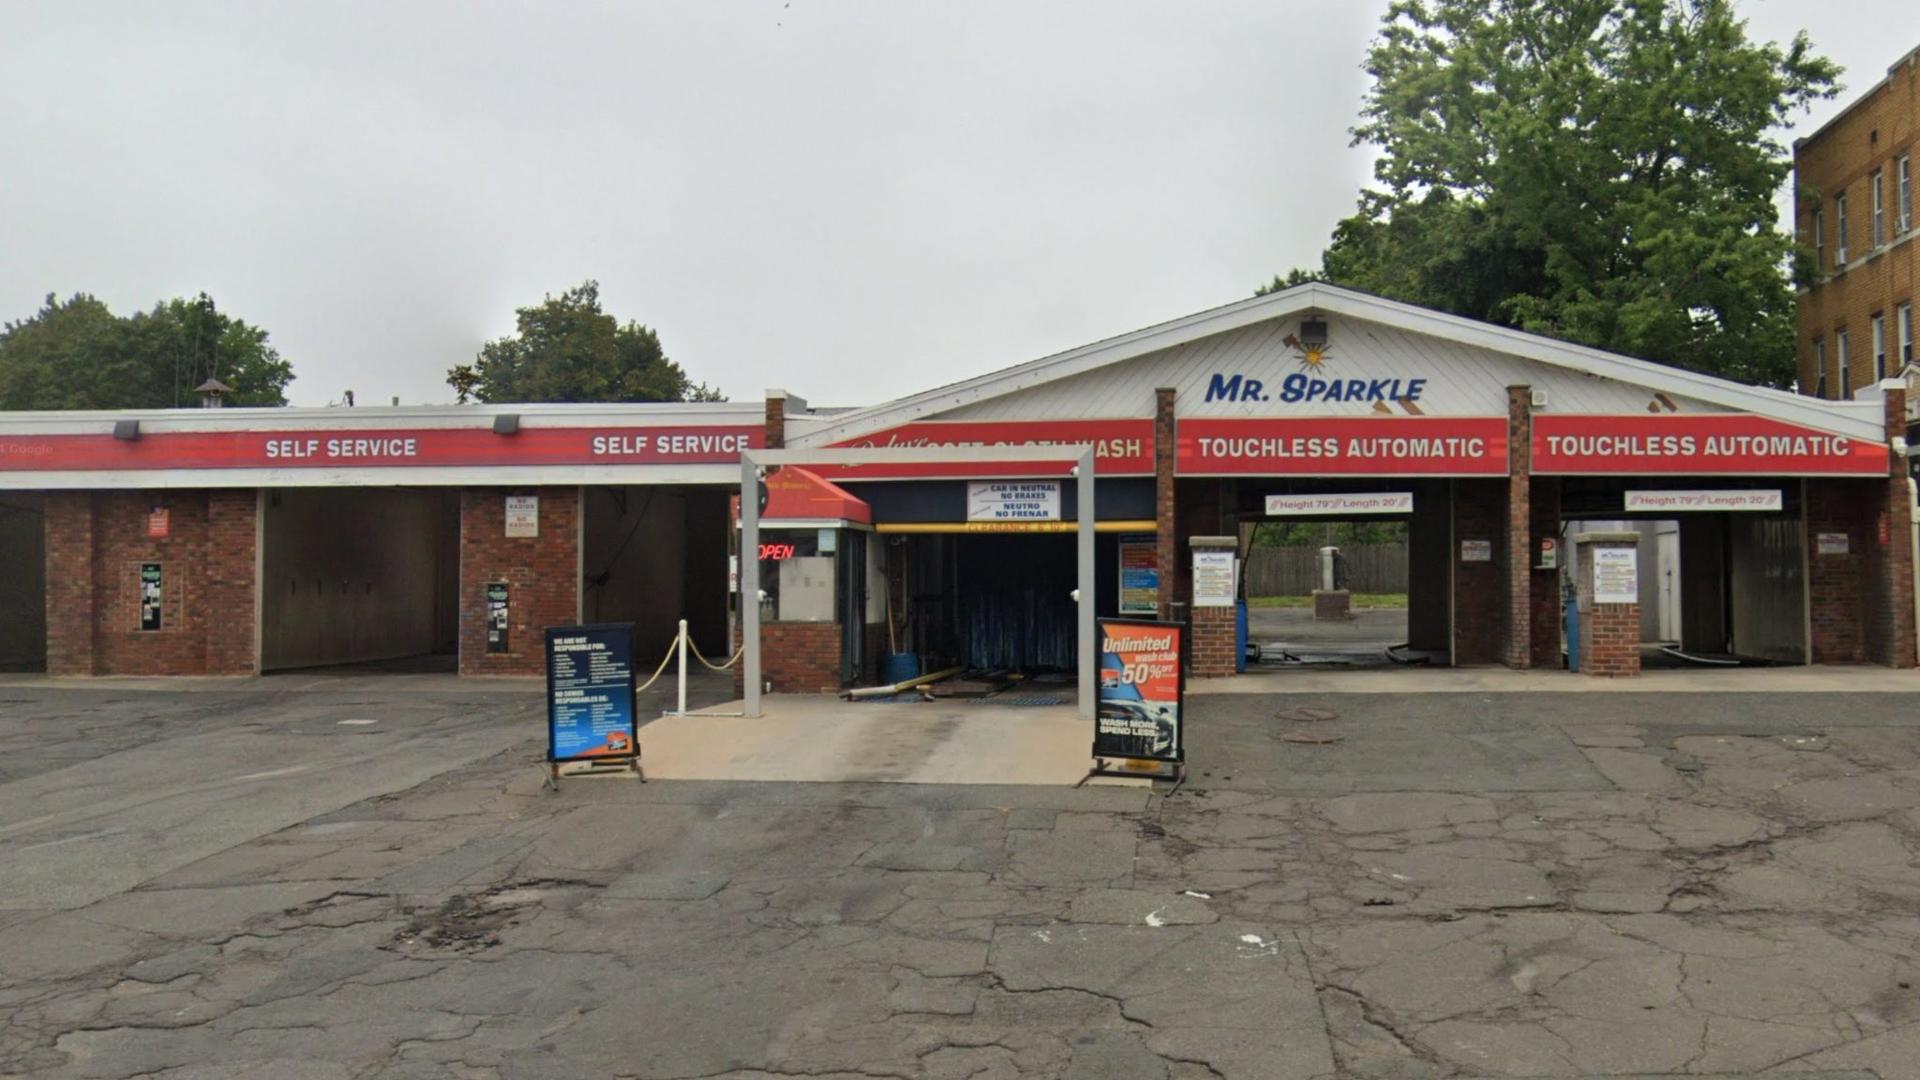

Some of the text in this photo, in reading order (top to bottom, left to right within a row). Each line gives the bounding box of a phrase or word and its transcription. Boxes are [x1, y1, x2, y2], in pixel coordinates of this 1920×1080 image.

[266, 438, 416, 458] SELF SERVICE
[593, 435, 749, 455] SELF SERVICE
[1198, 438, 1485, 457] TOUCHLESS AUTOMATIC
[1547, 435, 1849, 456] TOUCHLESS AUTOMATIC
[990, 484, 1007, 492] CAR
[1009, 484, 1018, 492] IN
[1279, 499, 1313, 511] Height
[1342, 498, 1379, 510] Length
[1639, 495, 1676, 507] Height
[1707, 495, 1746, 507] Length
[1103, 636, 1171, 653] Unlimited
[1135, 652, 1177, 662] wash club
[1100, 719, 1129, 727] WASH
[1100, 726, 1131, 735] SPEND
